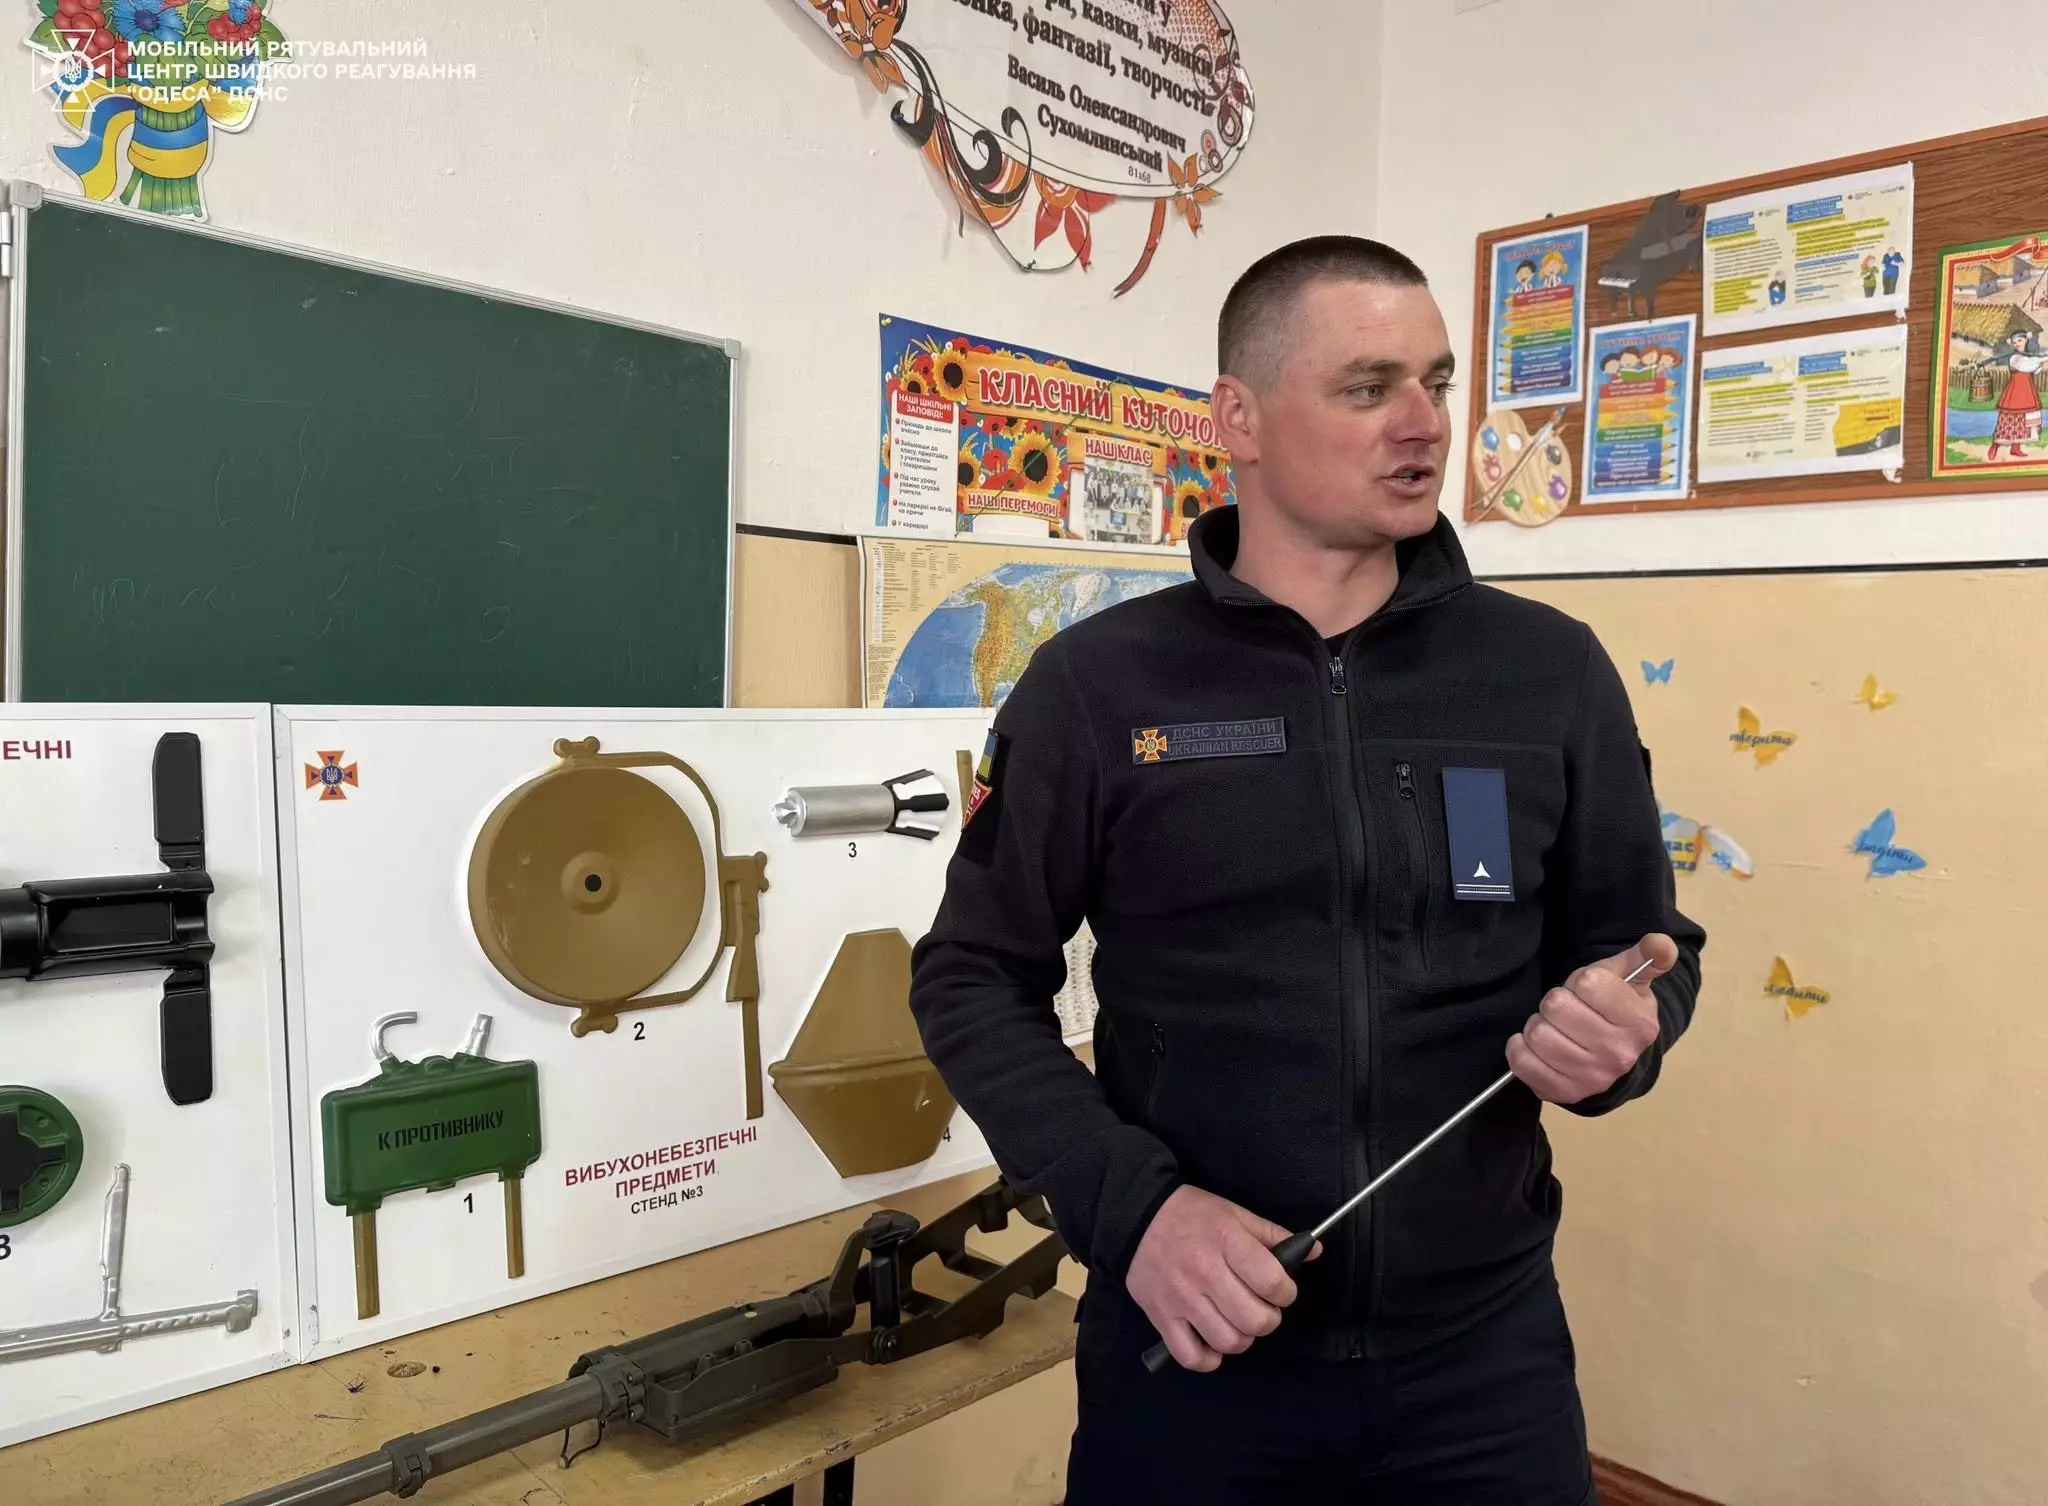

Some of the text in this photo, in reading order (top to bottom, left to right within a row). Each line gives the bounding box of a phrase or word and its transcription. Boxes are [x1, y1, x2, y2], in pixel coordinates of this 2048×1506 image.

[1082, 0, 1143, 50] казки,
[1022, 5, 1116, 77] фантазії,
[1007, 53, 1187, 154] Василь Олександрович
[1037, 103, 1163, 173] Сухомлинський
[898, 393, 952, 412] НАШІ ШКІЛЬНІ
[978, 366, 1228, 451] КЛАСНИЙ КУТОЧО
[1084, 437, 1153, 466] НАШ КЛАС
[967, 492, 1058, 517] НАШІ ПЕРЕМОГИ
[1173, 721, 1276, 742] ДСНС УКРАЇНИ
[3, 740, 72, 760] ЕЧНІ
[1168, 737, 1281, 756] UKRAINIAN RESCUER
[848, 841, 857, 858] 3
[633, 1021, 646, 1041] 2
[378, 1110, 504, 1151] К ПРОТИВНИКУ
[943, 1127, 952, 1143] 4
[565, 1126, 757, 1186] ВИБУХОНЕБЕЗПЕЧНІ
[615, 1159, 716, 1198] ПРЕДМЕТИ
[463, 1192, 474, 1214] 1
[631, 1185, 704, 1214] СТЕНД №3
